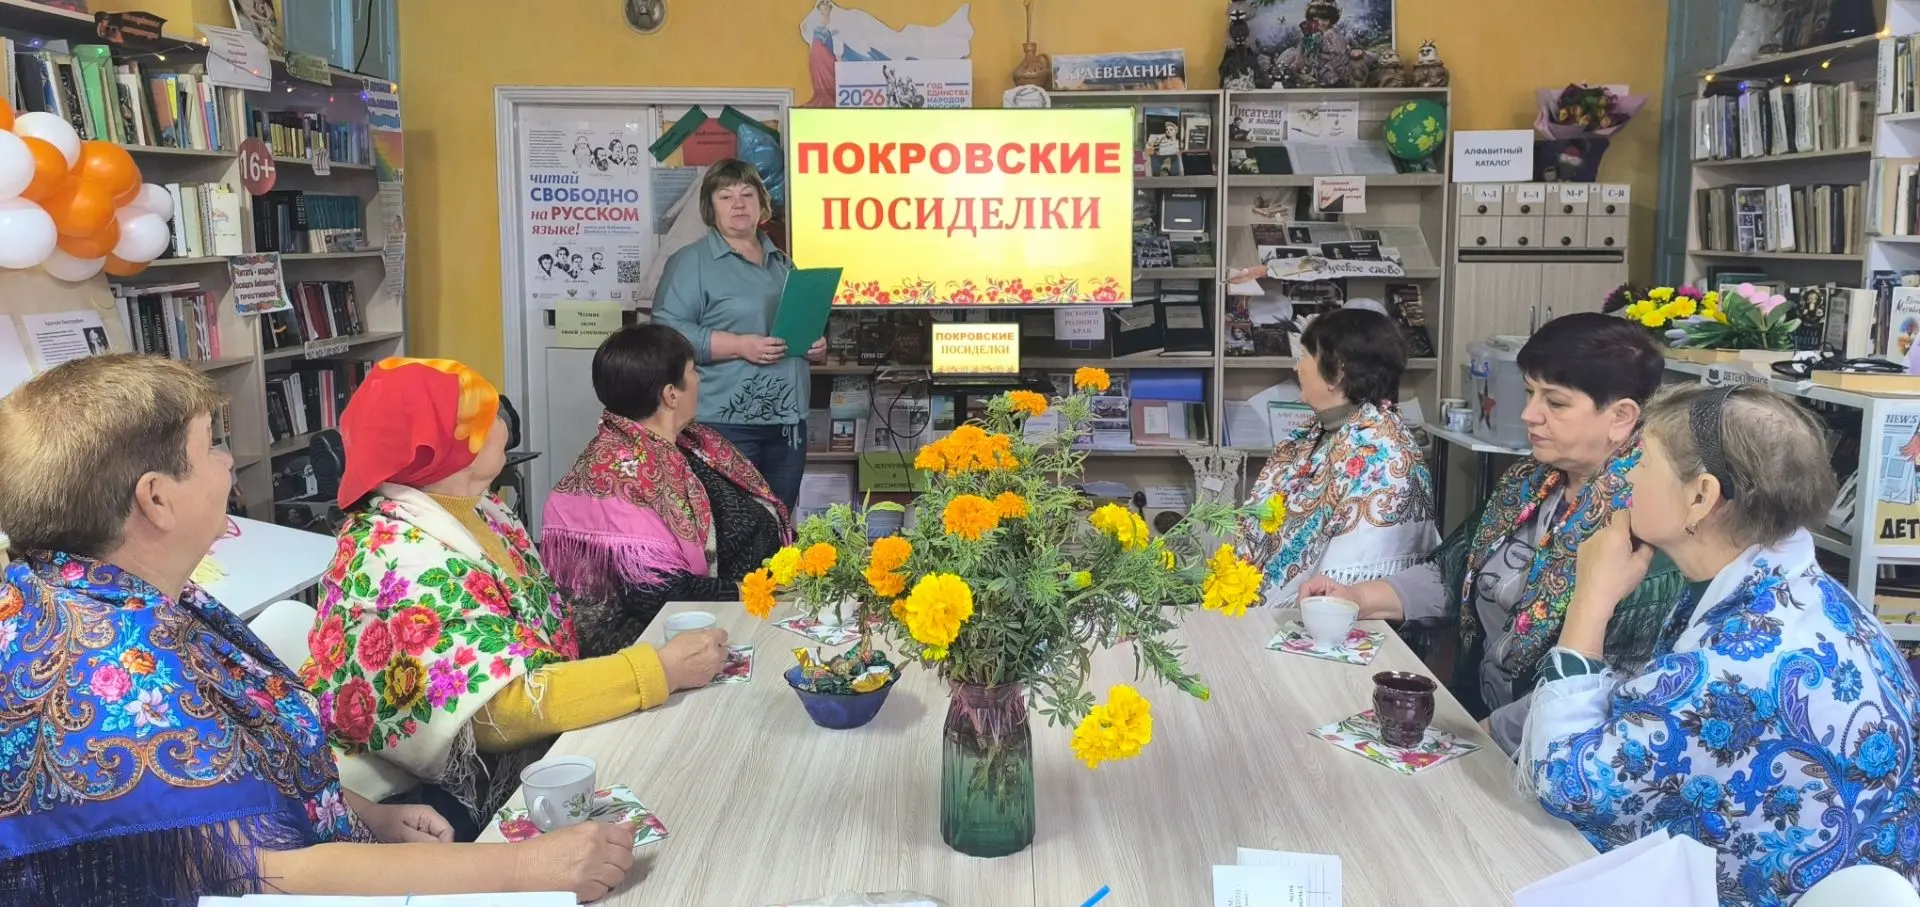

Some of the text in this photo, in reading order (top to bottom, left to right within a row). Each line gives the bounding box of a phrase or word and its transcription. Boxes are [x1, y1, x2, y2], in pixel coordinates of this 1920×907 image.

[1067, 62, 1177, 81] КРАЕВЕДЕНИЕ
[926, 82, 943, 90] ГОД
[838, 89, 886, 106] 2026
[926, 89, 969, 97] ЕДИНСТВА
[1229, 103, 1283, 119] Писатели
[1464, 146, 1523, 156] АЛФАВИТНЫЙ
[798, 142, 1121, 174] ПОКРОВСКИЕ
[1475, 159, 1512, 167] КАТАЛОГ
[240, 152, 275, 182] 16+
[529, 170, 579, 185] читай
[530, 187, 639, 205] СВОБОДНО
[1566, 189, 1584, 198] М-Р
[1607, 189, 1625, 198] С-Я
[530, 206, 640, 221] на РУССКОМ
[821, 196, 1101, 238] ПОСИДЕЛКИ
[531, 222, 580, 235] языке!
[1368, 264, 1402, 275] слово
[935, 332, 1015, 341] ПОКРОВСКИЕ
[941, 344, 1010, 355] ПОСИДЕЛКИ
[1885, 414, 1918, 424] NEWS
